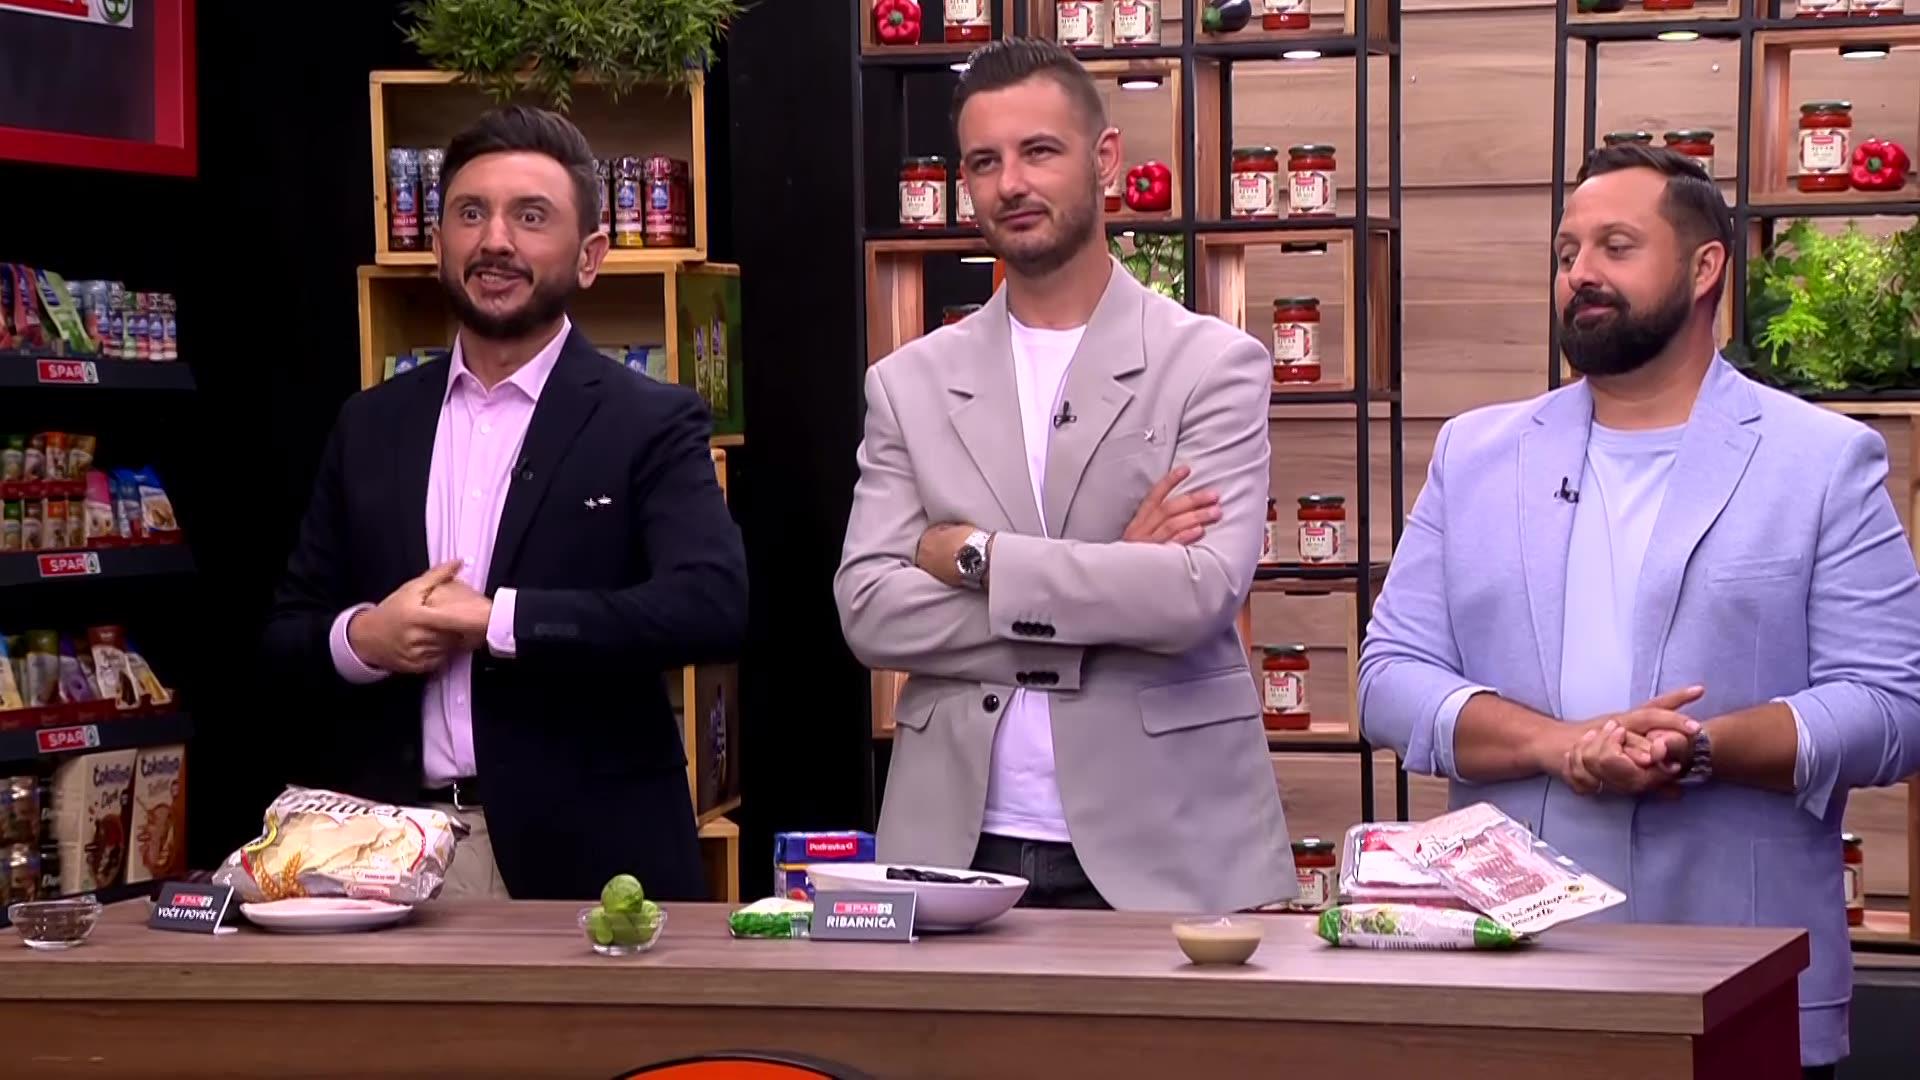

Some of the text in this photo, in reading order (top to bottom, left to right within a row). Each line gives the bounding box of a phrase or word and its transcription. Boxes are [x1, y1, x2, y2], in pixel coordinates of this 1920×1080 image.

[48, 363, 84, 379] SPAR
[50, 556, 86, 573] SPAR
[48, 731, 84, 748] SPAR
[809, 841, 846, 851] Podravka
[845, 903, 879, 914] SPAR
[826, 915, 896, 929] RIBARNICA
